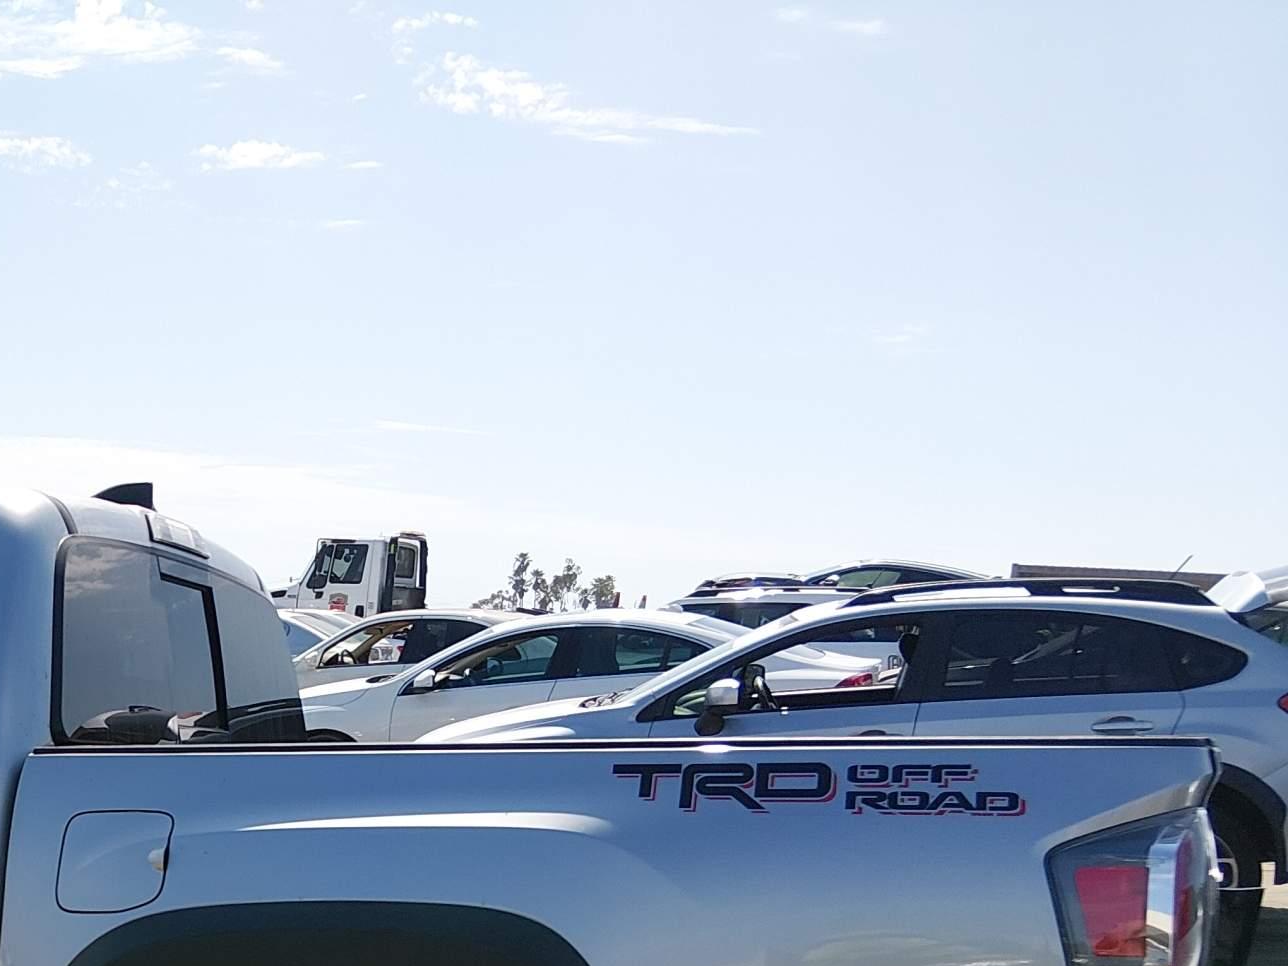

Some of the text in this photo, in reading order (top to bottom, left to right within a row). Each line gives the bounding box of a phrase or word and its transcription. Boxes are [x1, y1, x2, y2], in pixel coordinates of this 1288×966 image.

[612, 761, 978, 813] TRD OFF
[844, 790, 1027, 816] ROAD
